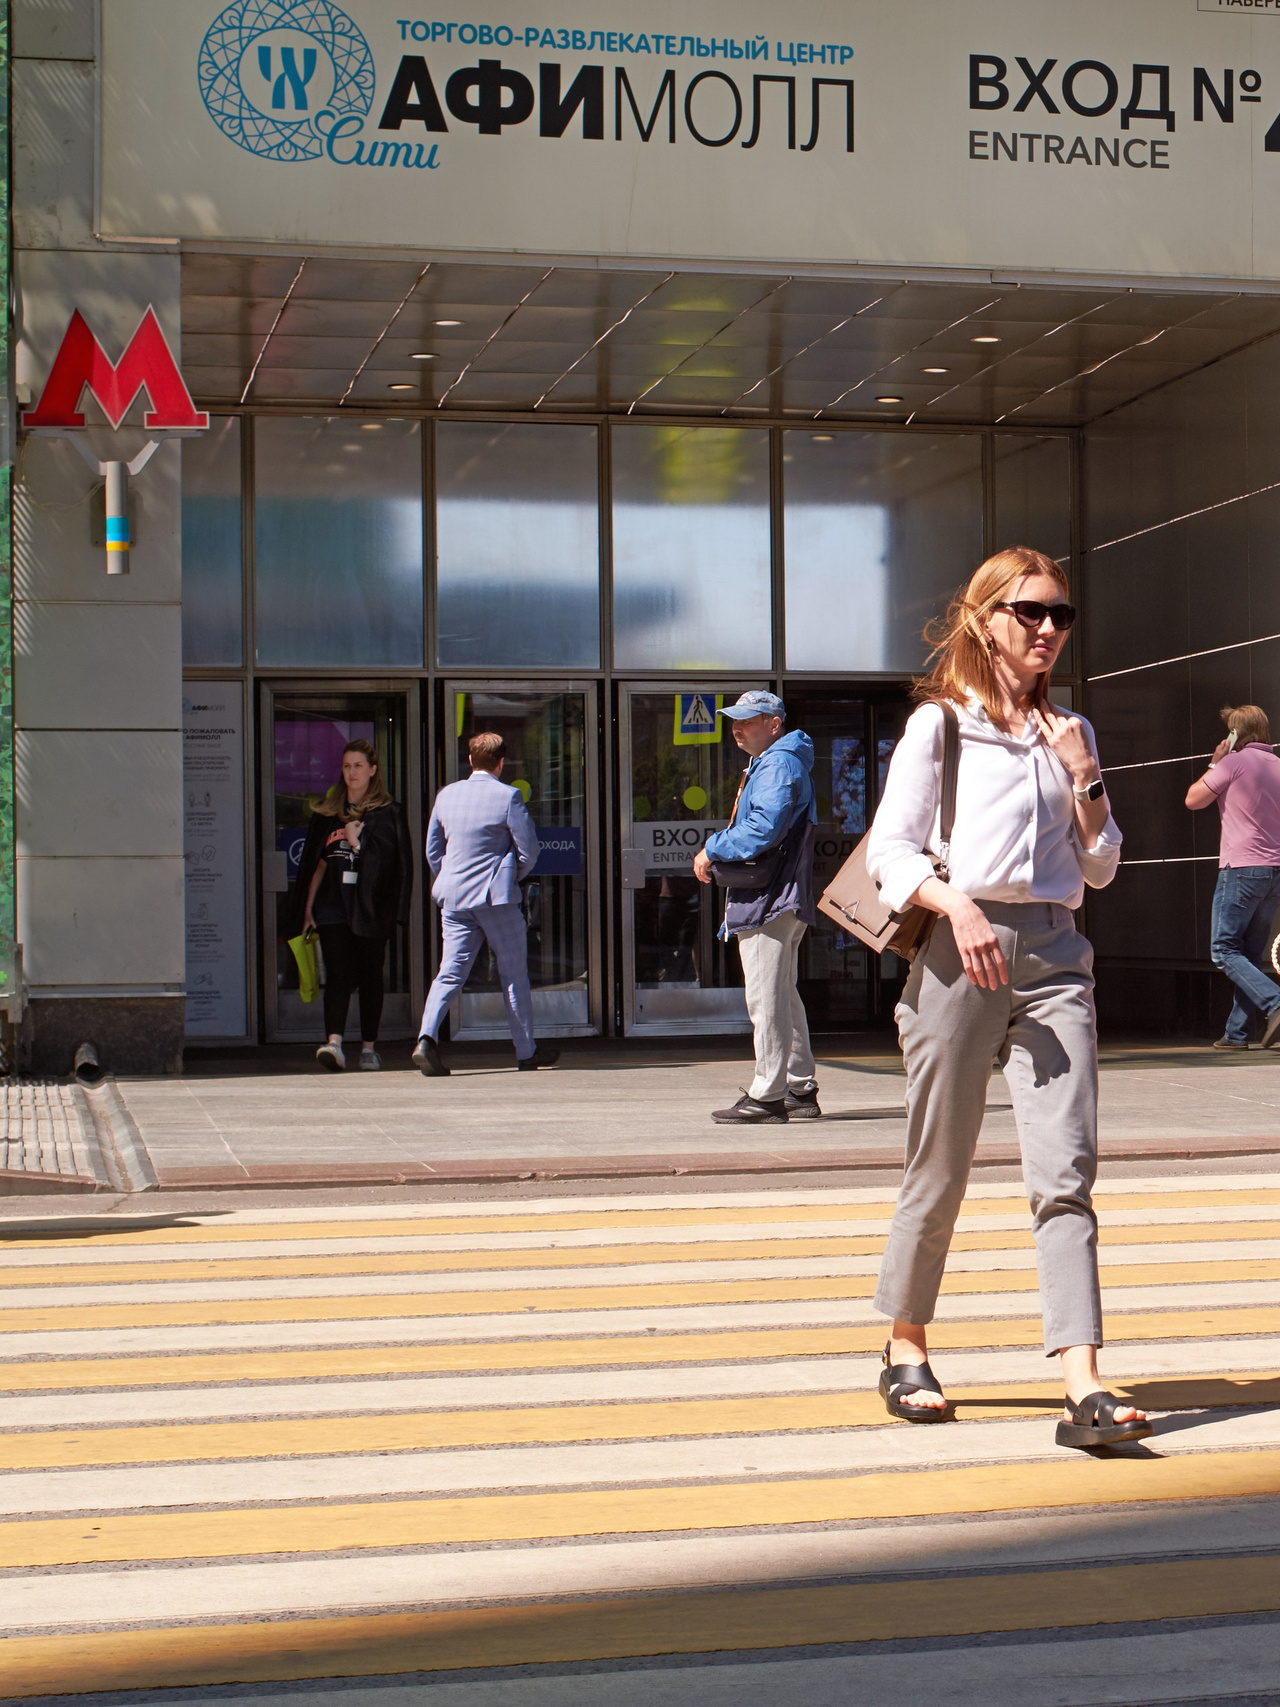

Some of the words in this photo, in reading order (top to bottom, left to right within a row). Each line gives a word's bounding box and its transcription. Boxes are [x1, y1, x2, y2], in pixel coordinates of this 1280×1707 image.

[396, 20, 769, 62] ТОРГОВО-РАЗВЛЕКАТЕЛЬНЫЙ
[777, 41, 854, 66] ЦЕНТР
[378, 54, 855, 153] АФИМОЛЛ
[969, 54, 1175, 132] ВХОД
[314, 109, 440, 170] Сити
[969, 130, 1170, 169] ENTRANCE
[538, 840, 576, 851] ОХОДА
[653, 852, 698, 863] ENTRA
